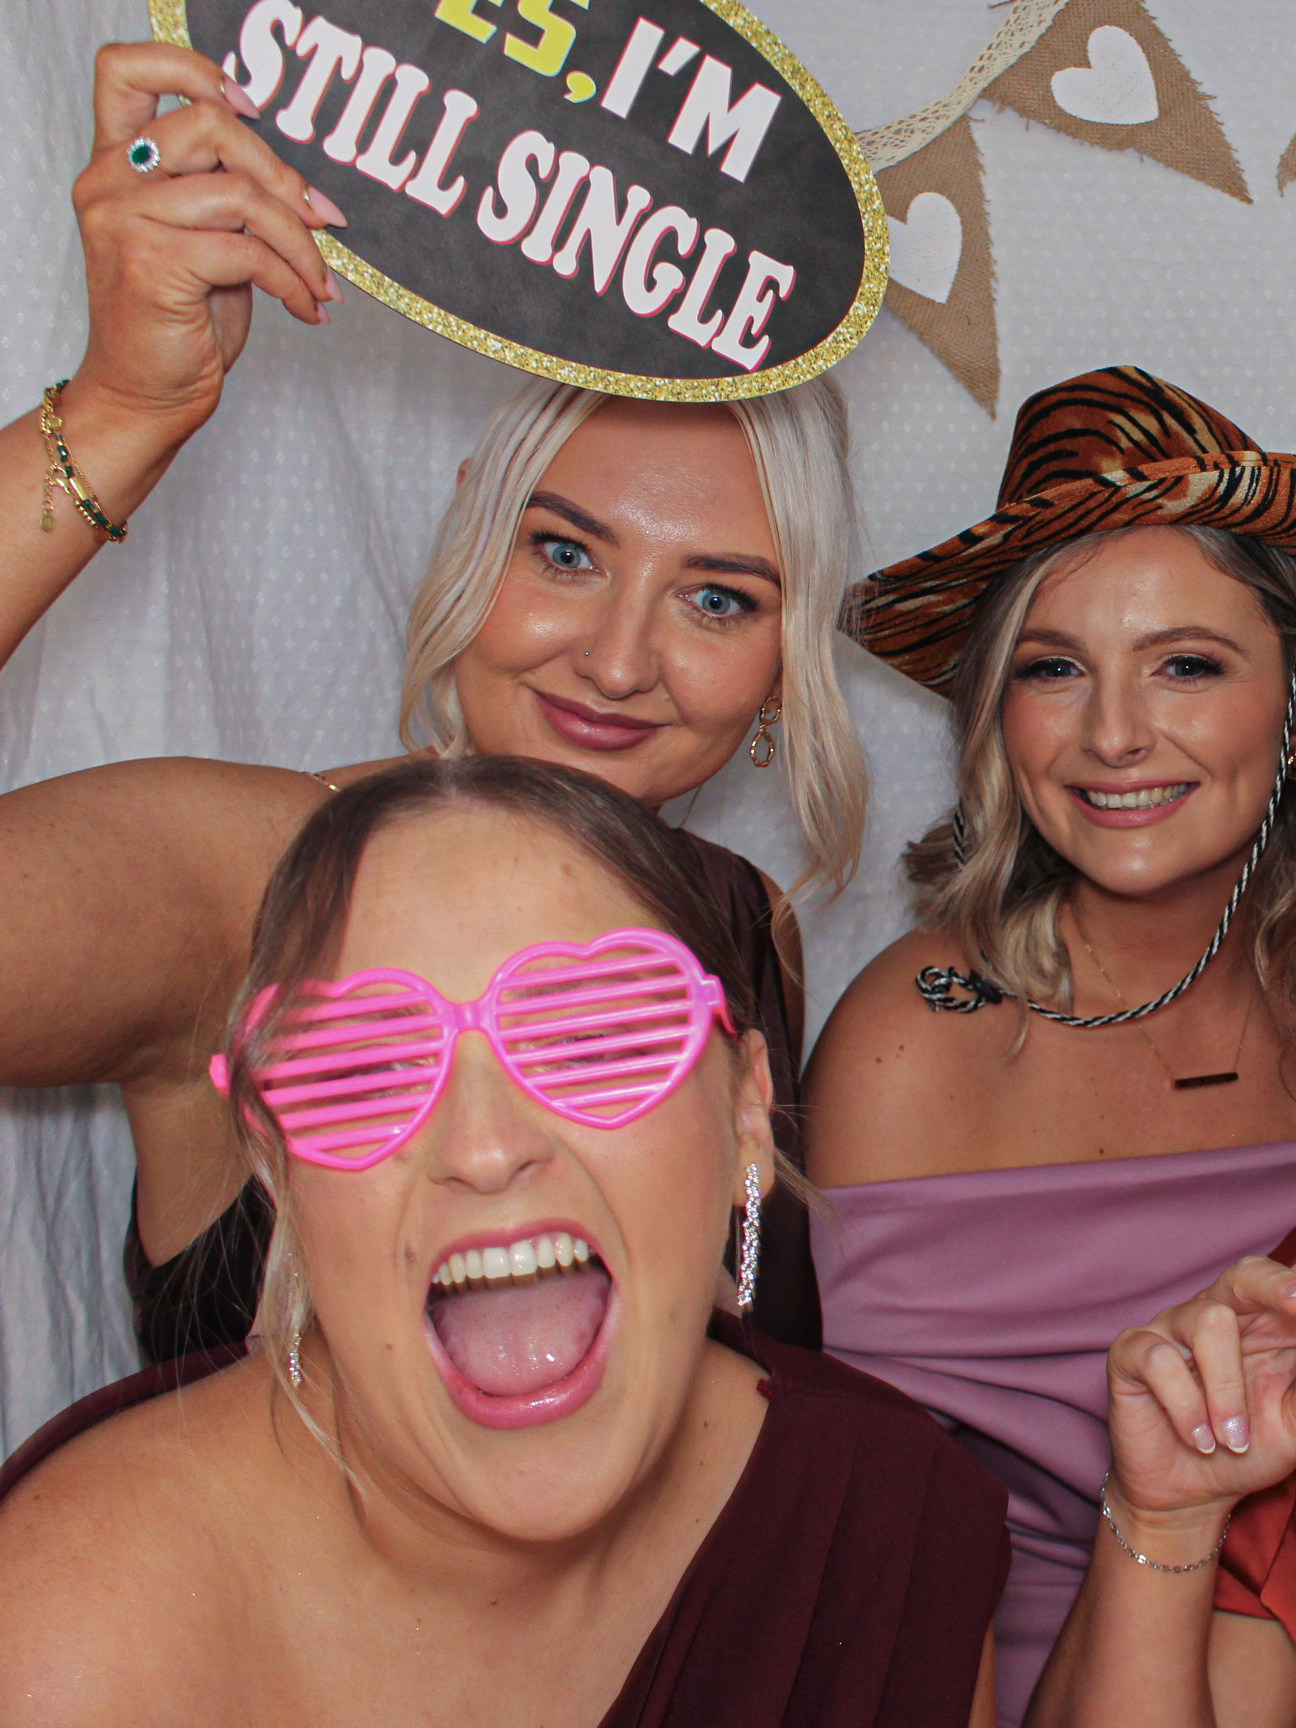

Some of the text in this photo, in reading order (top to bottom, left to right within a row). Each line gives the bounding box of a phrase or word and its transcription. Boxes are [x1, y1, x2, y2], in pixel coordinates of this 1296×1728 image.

[222, 0, 796, 373] STILL SINGLE
[600, 16, 782, 183] I'M
